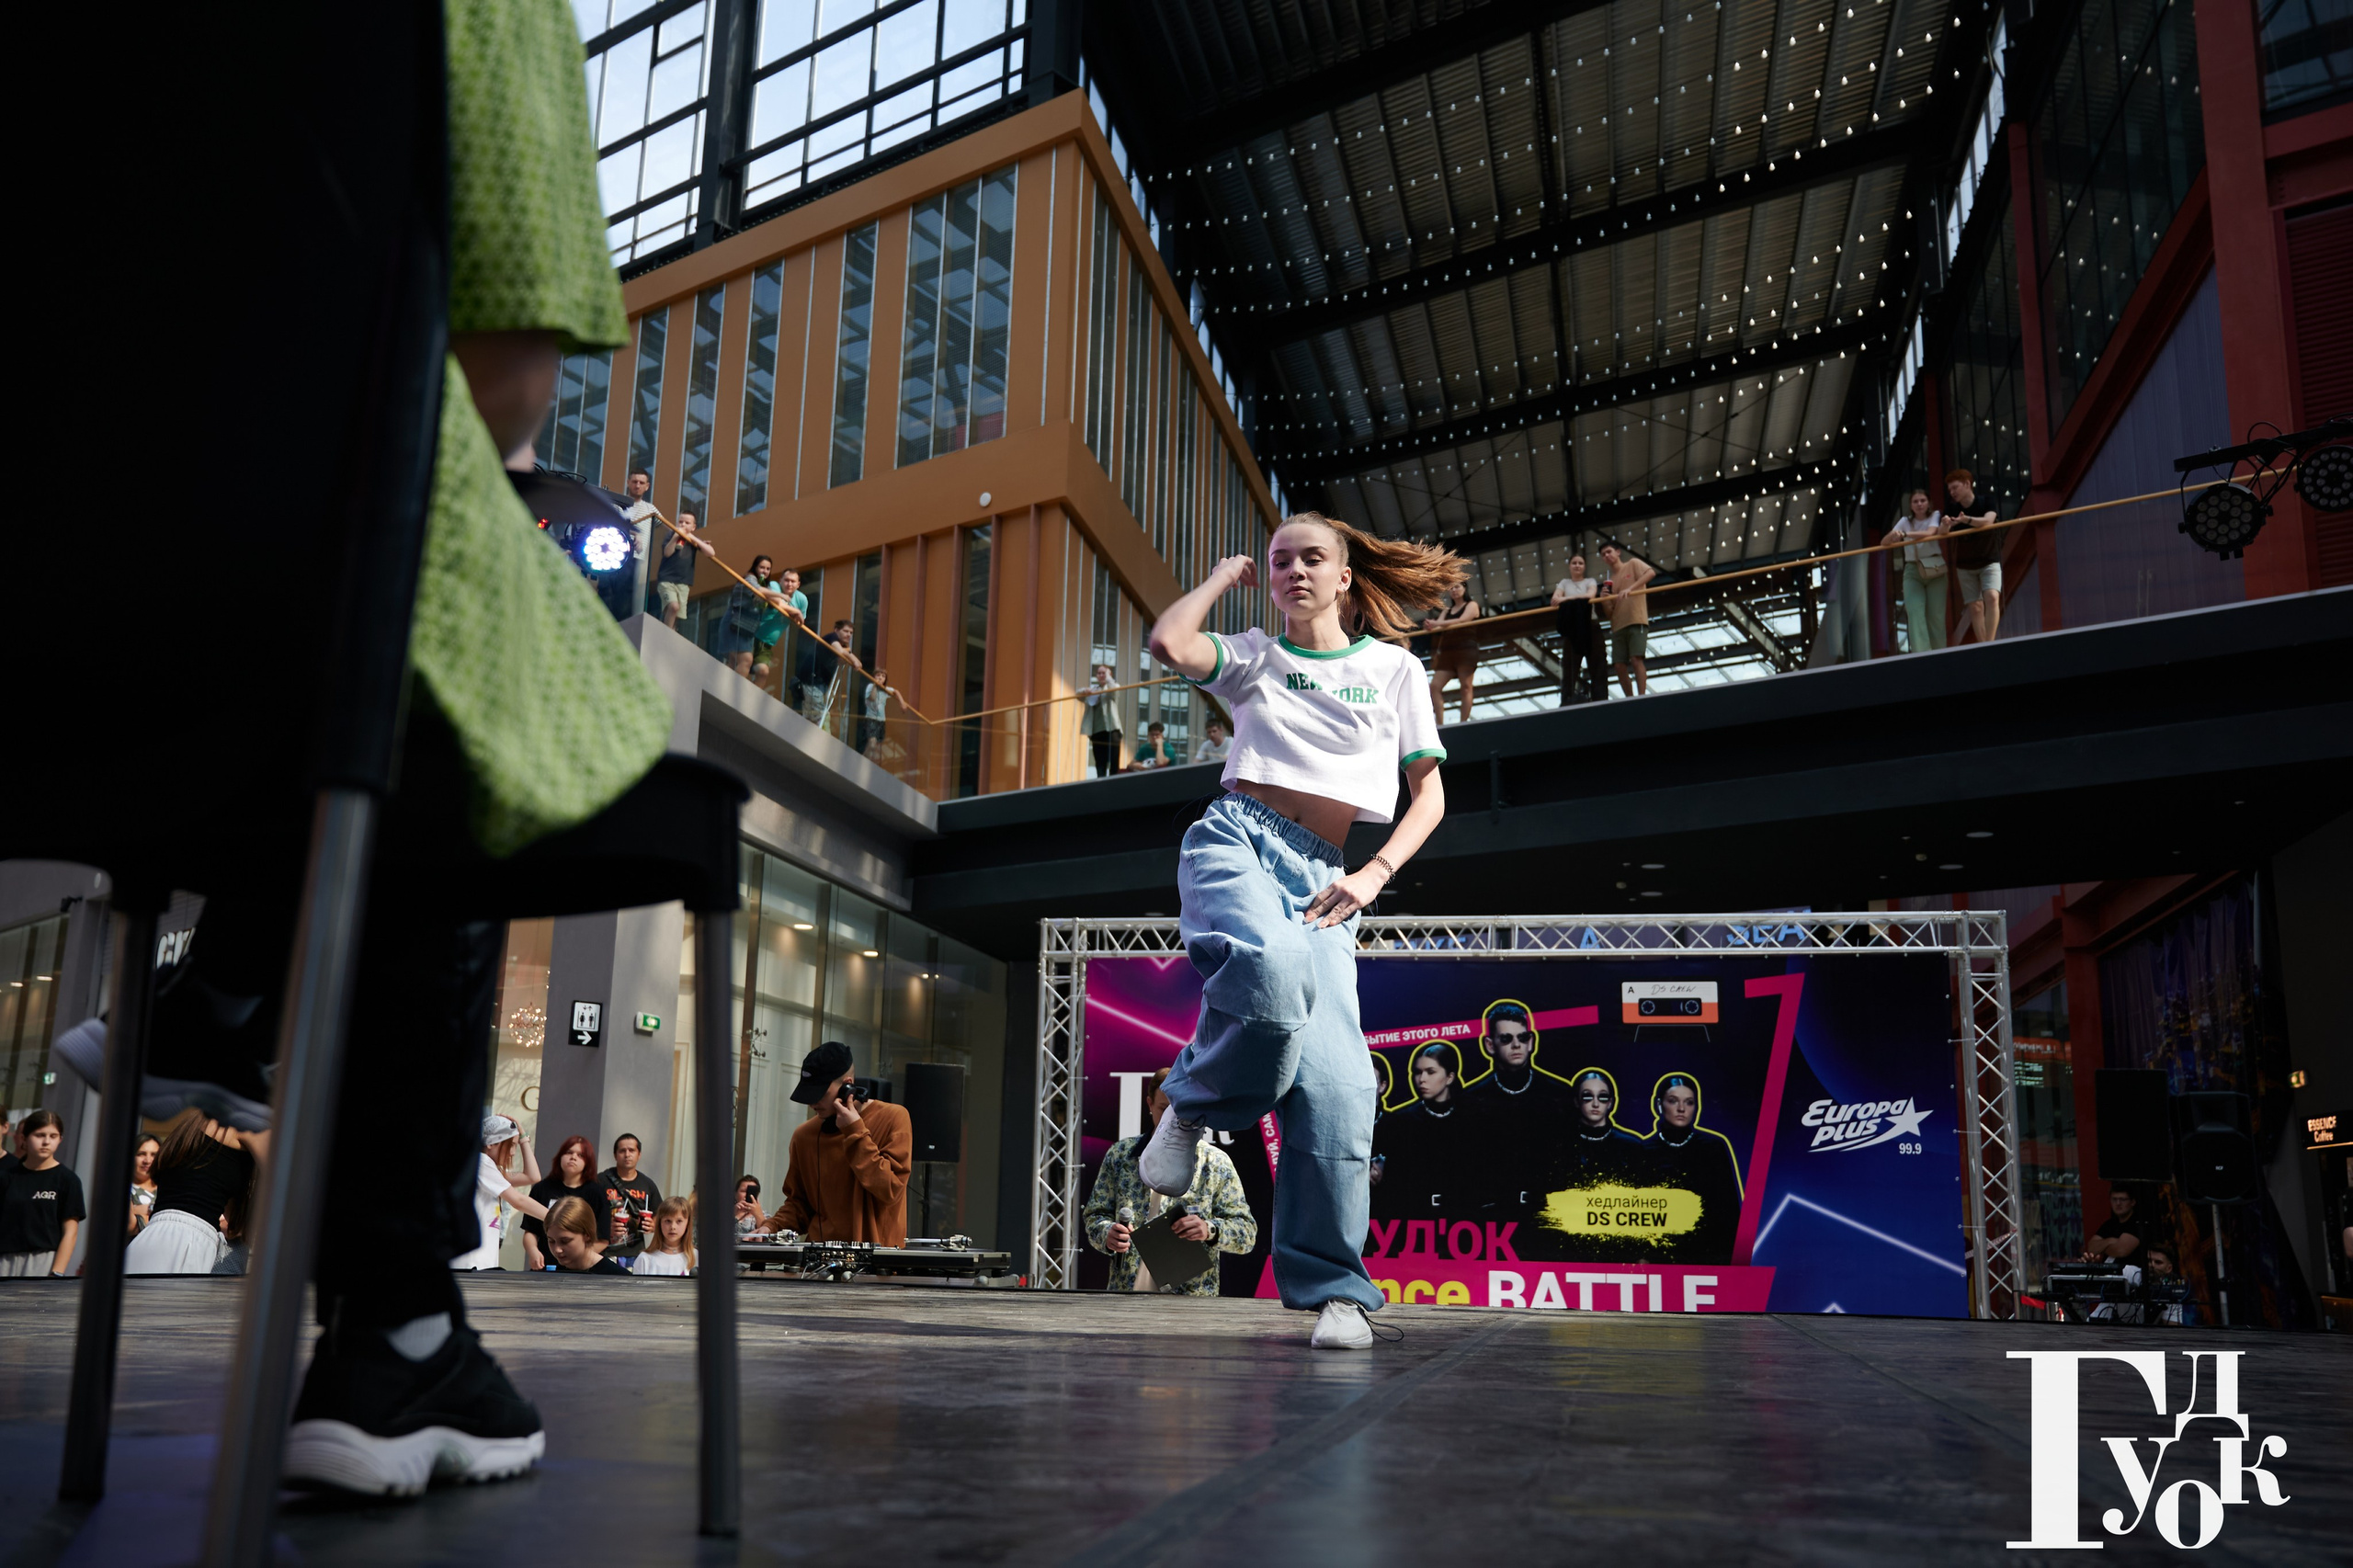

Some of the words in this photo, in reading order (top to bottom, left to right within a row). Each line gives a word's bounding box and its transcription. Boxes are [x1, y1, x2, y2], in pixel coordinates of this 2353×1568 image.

[1364, 1032, 1400, 1045] БЫТИЕ
[1403, 1028, 1438, 1040] ЭТОГО
[1441, 1024, 1471, 1036] ЛЕТА
[1801, 1099, 1908, 1127] Europa
[1899, 1142, 1922, 1154] 99.9
[32, 1190, 57, 1200] AGR
[606, 1188, 646, 1200] SLSH
[1586, 1196, 1667, 1210] хедлайнер
[1587, 1211, 1610, 1226] DS
[1616, 1212, 1667, 1227] CREW
[1370, 1218, 1521, 1261] УД'ОК
[1370, 1278, 1471, 1305] nce
